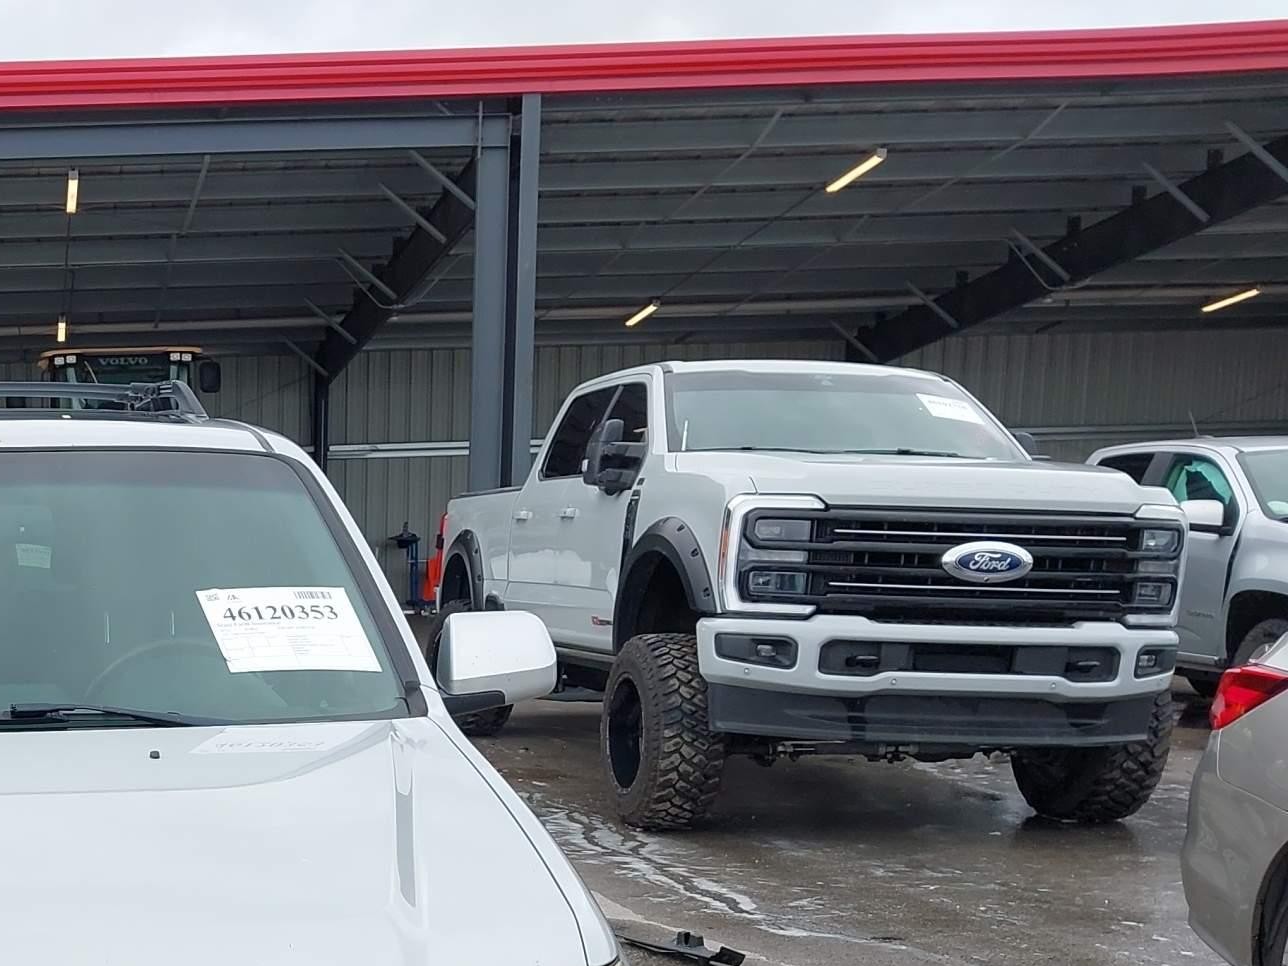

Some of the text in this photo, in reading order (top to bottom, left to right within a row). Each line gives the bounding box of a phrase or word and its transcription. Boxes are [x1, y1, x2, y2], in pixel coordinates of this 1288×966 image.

[99, 357, 149, 366] VOLVO
[969, 552, 1012, 571] Ford
[223, 604, 339, 622] 46120353
